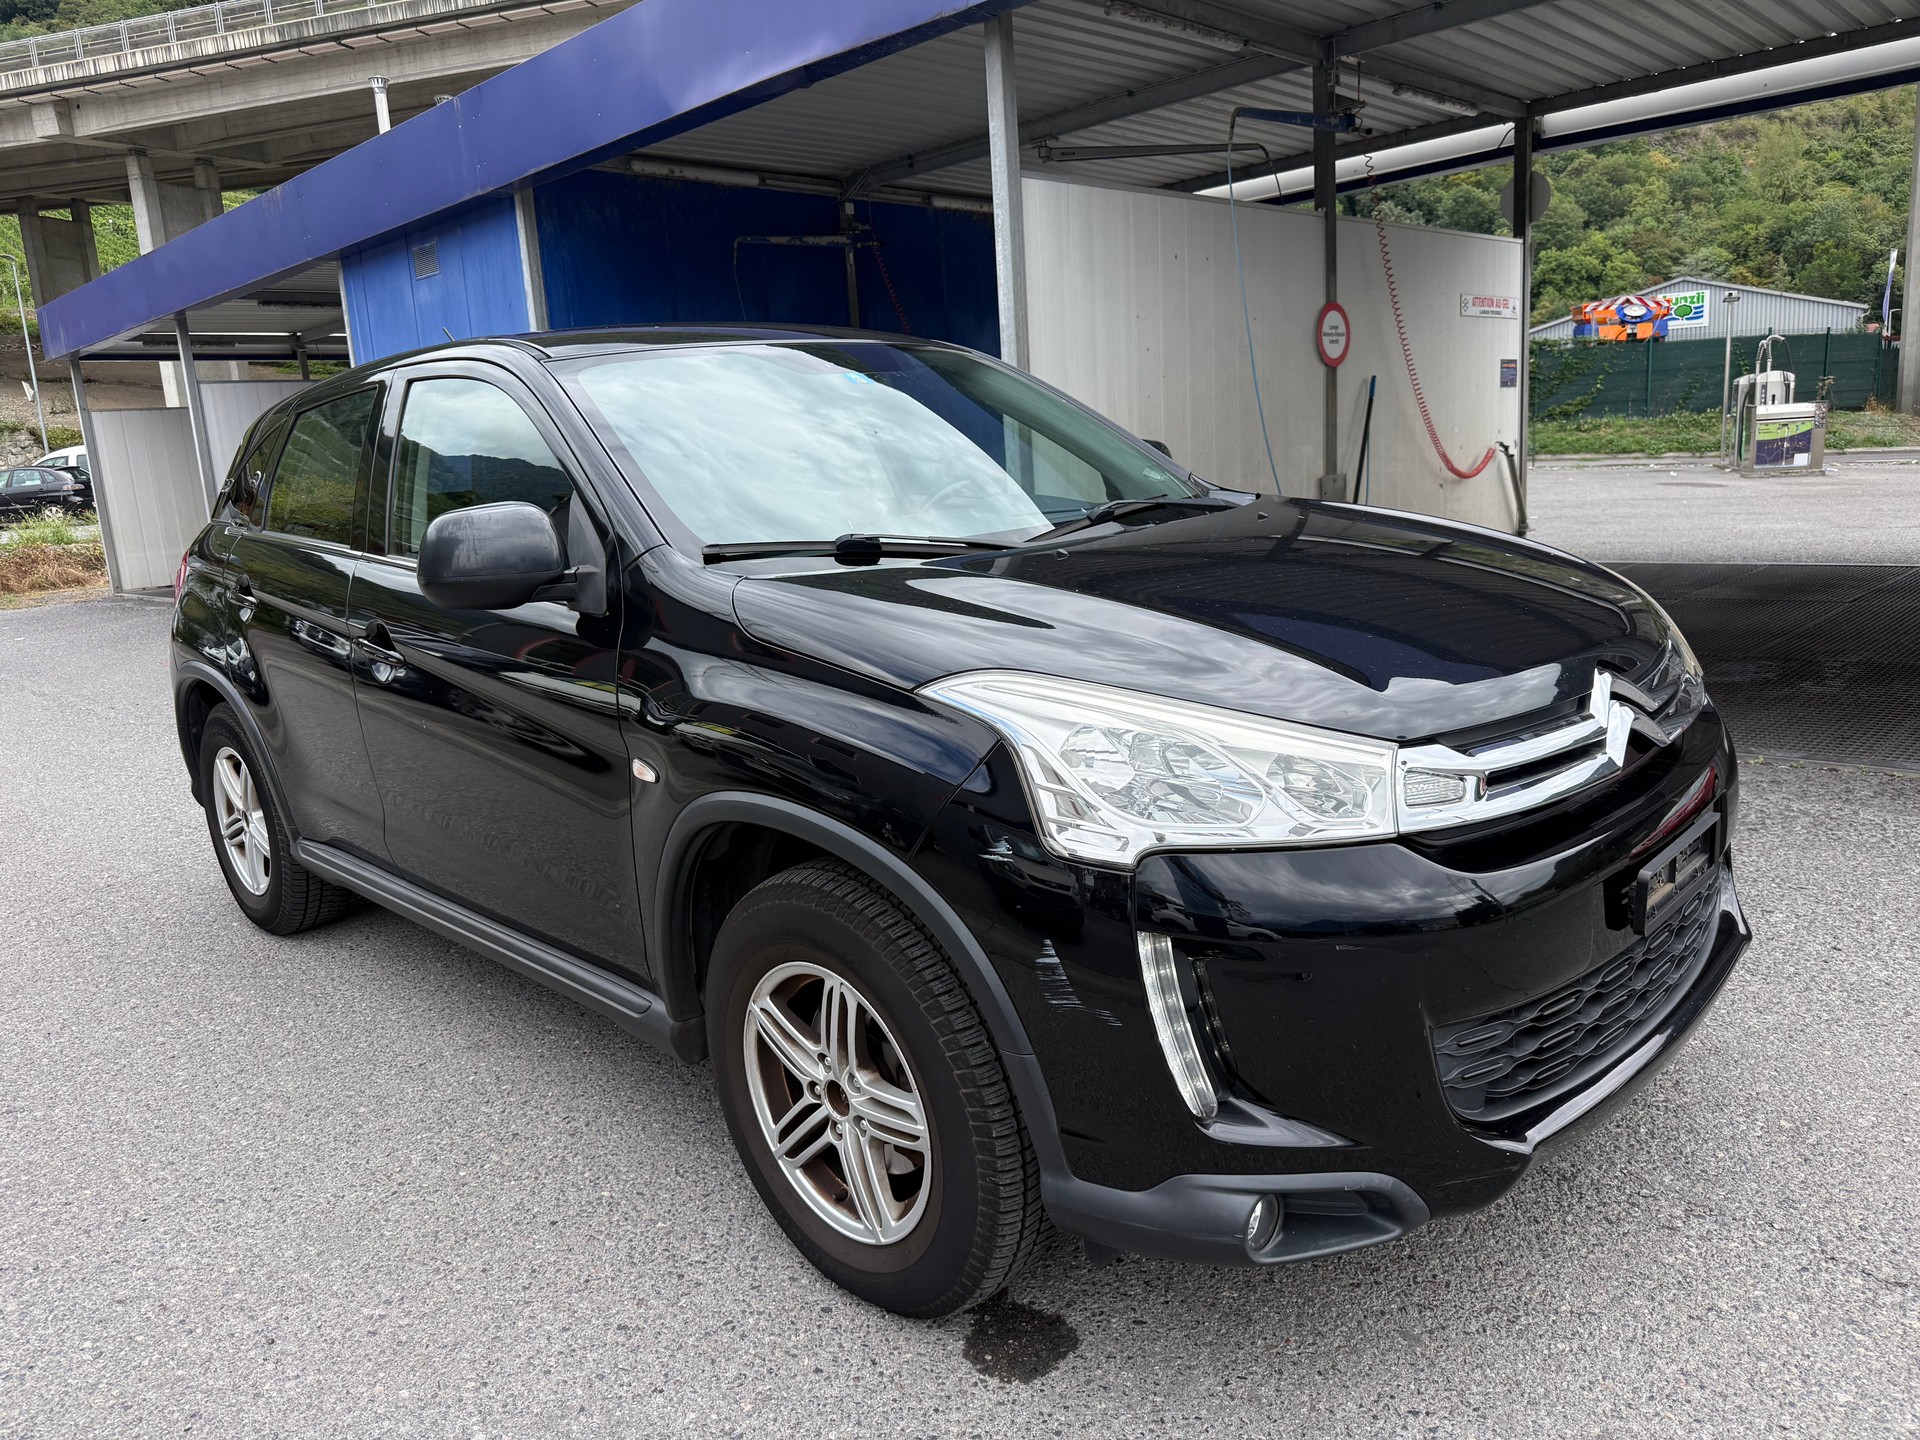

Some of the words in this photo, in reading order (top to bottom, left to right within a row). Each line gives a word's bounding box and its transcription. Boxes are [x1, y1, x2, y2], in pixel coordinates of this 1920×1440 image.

[1472, 296, 1494, 308] ATTENTION
[1495, 298, 1501, 308] AU
[1662, 292, 1704, 306] unzli
